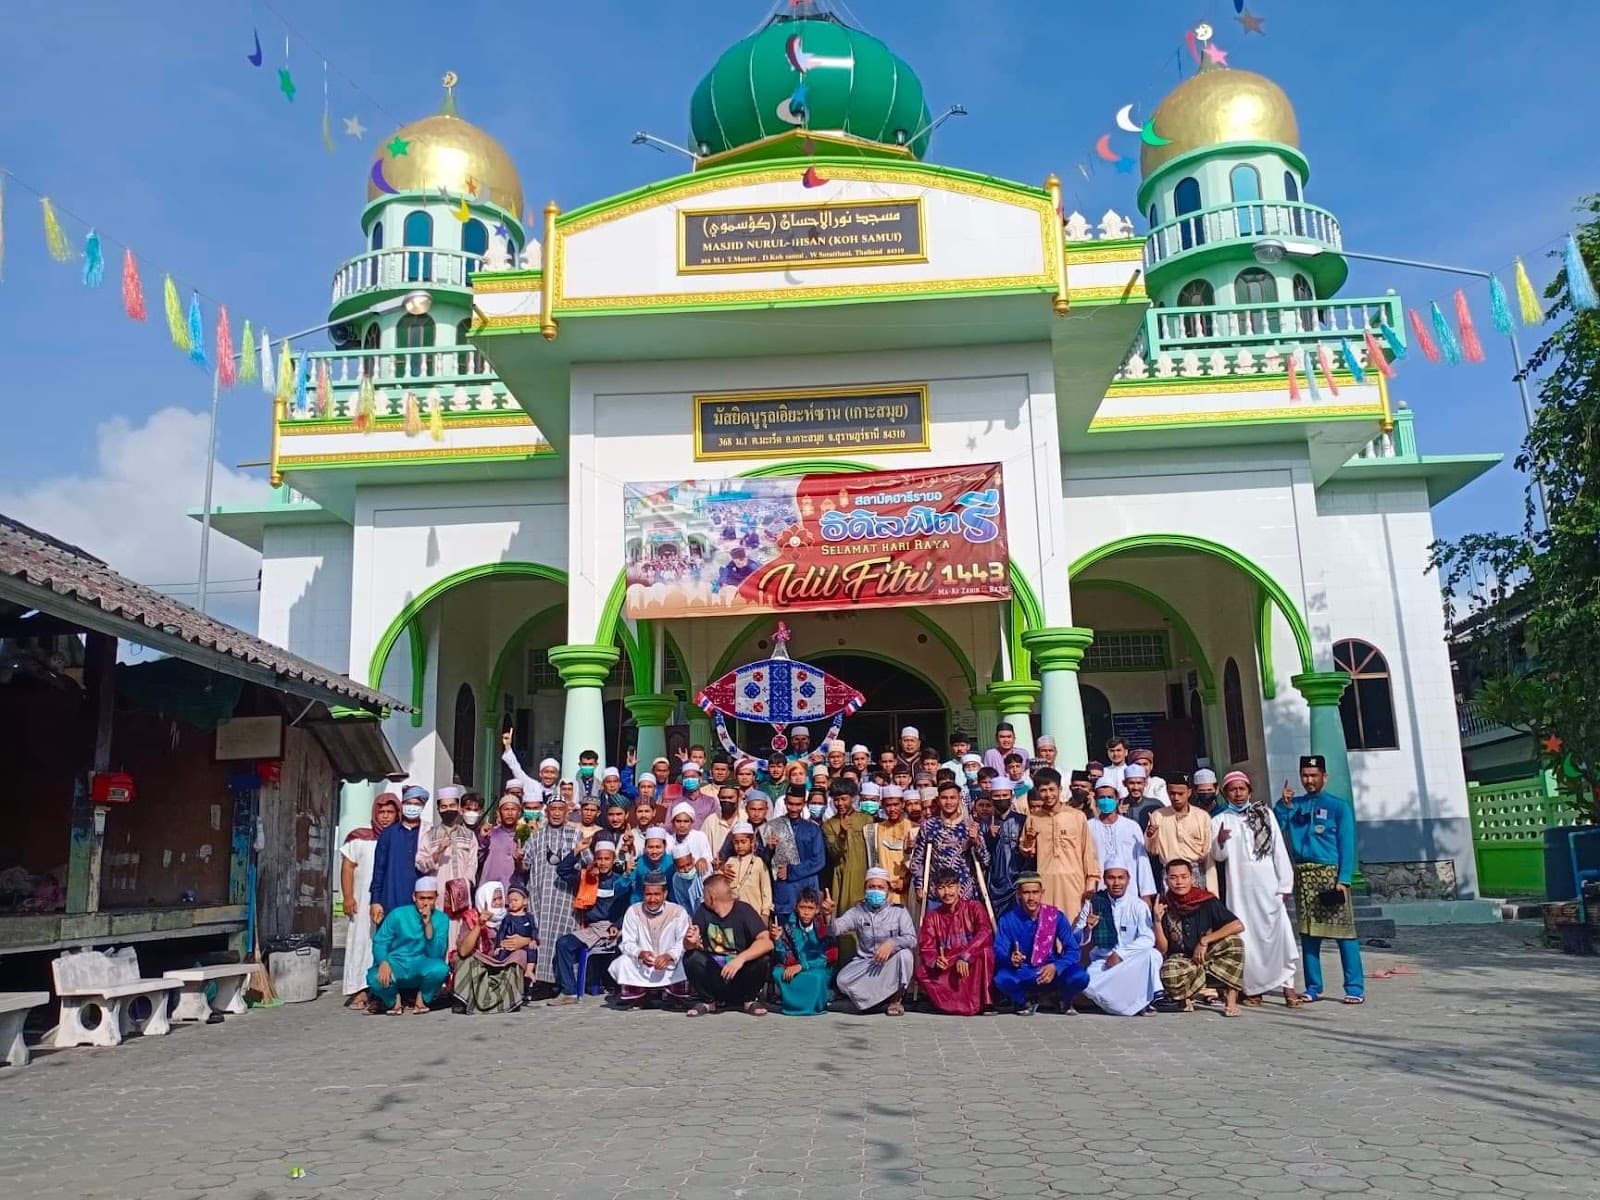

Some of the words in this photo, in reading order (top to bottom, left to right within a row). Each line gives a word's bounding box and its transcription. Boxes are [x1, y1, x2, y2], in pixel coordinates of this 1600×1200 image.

[855, 212, 900, 226] مسجد
[703, 241, 743, 251] MASJID
[829, 235, 858, 246] (KOH
[862, 232, 902, 243] SAMUI)
[844, 403, 909, 423] (เกาะสมุย)
[719, 437, 732, 447] 368
[883, 429, 906, 440] 84310
[758, 563, 842, 606] Idil
[841, 555, 935, 602] Fitri
[940, 561, 1005, 586] 1443
